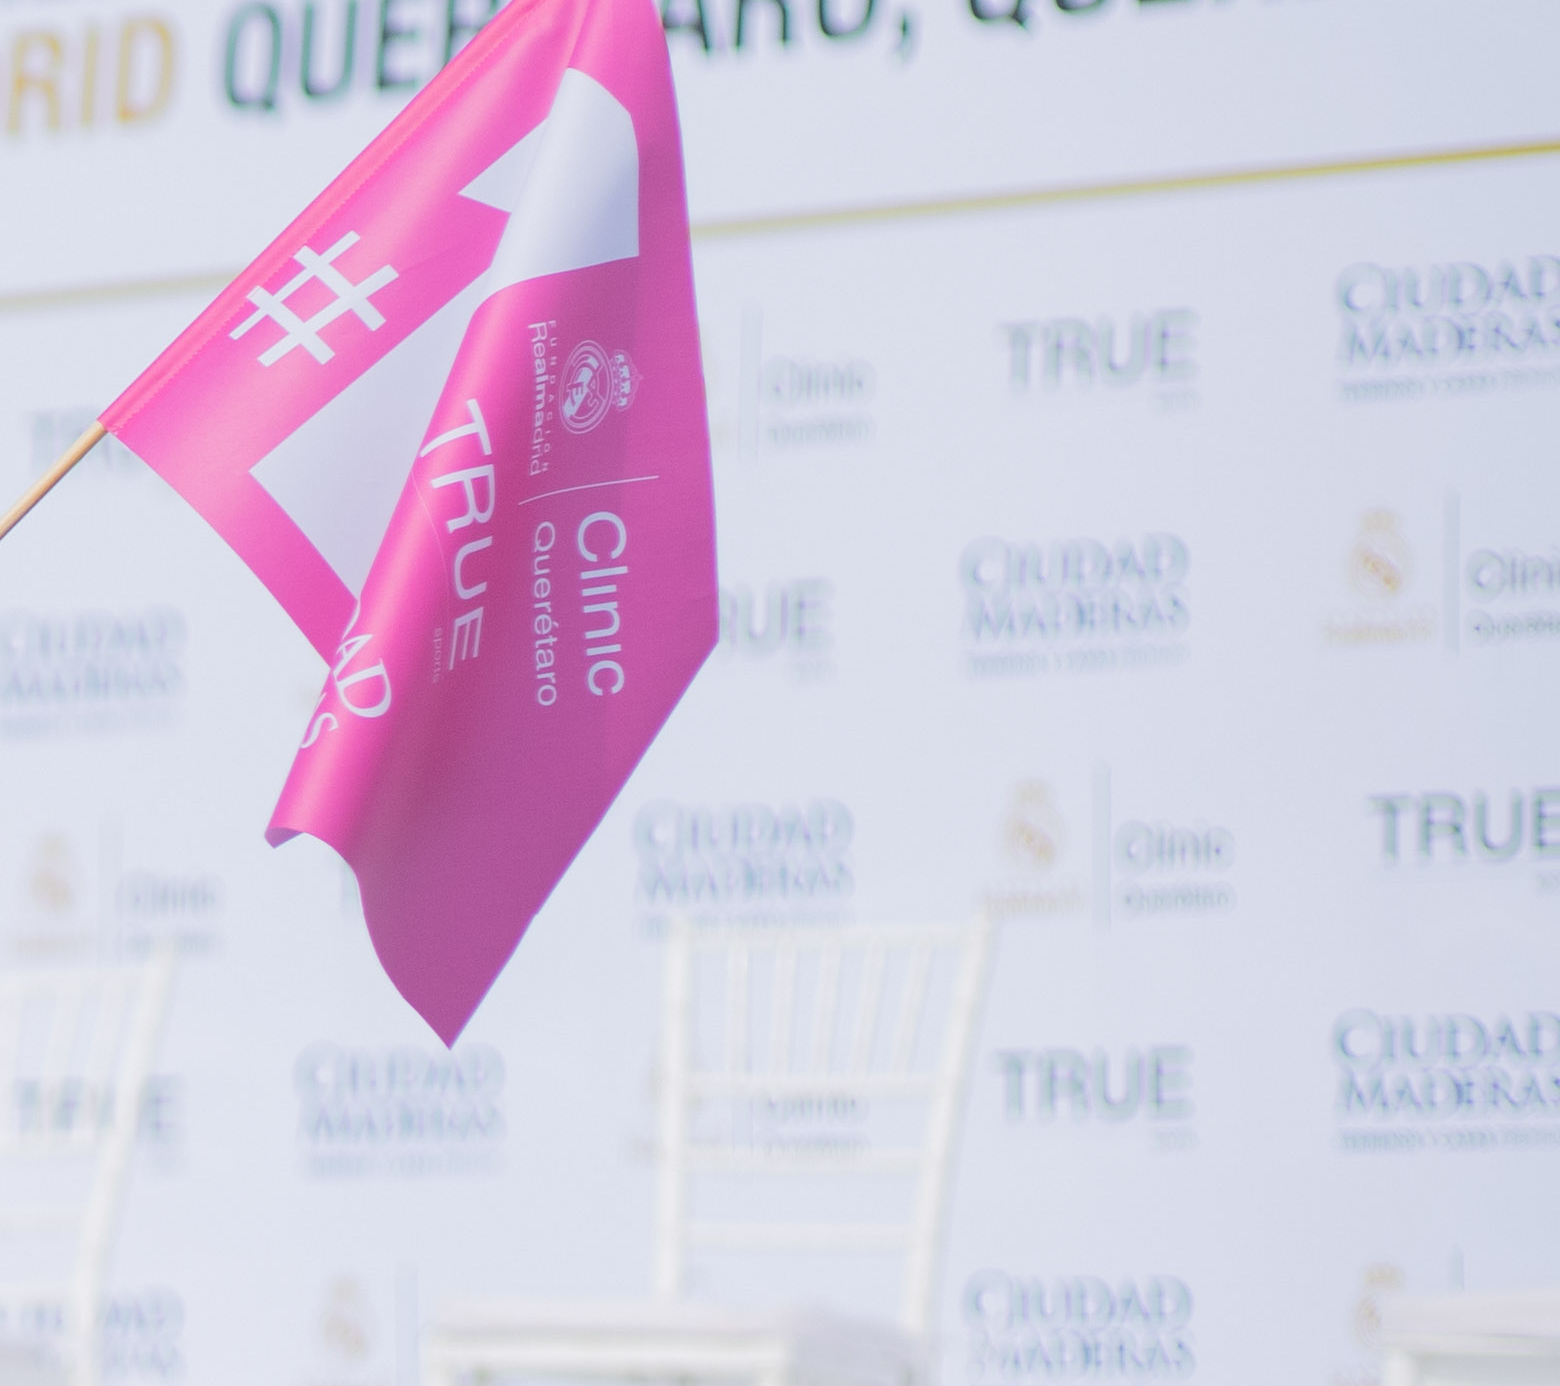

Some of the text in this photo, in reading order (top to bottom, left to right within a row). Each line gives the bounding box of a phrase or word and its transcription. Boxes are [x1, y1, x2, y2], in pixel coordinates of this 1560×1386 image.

[528, 321, 551, 477] Realmadrid
[998, 307, 1202, 396] TRUE
[420, 398, 496, 671] TRUE
[577, 511, 629, 697] Clinic
[532, 520, 560, 707] Querétaro
[1366, 788, 1560, 868] TRUE
[996, 1046, 1196, 1123] TRUE
